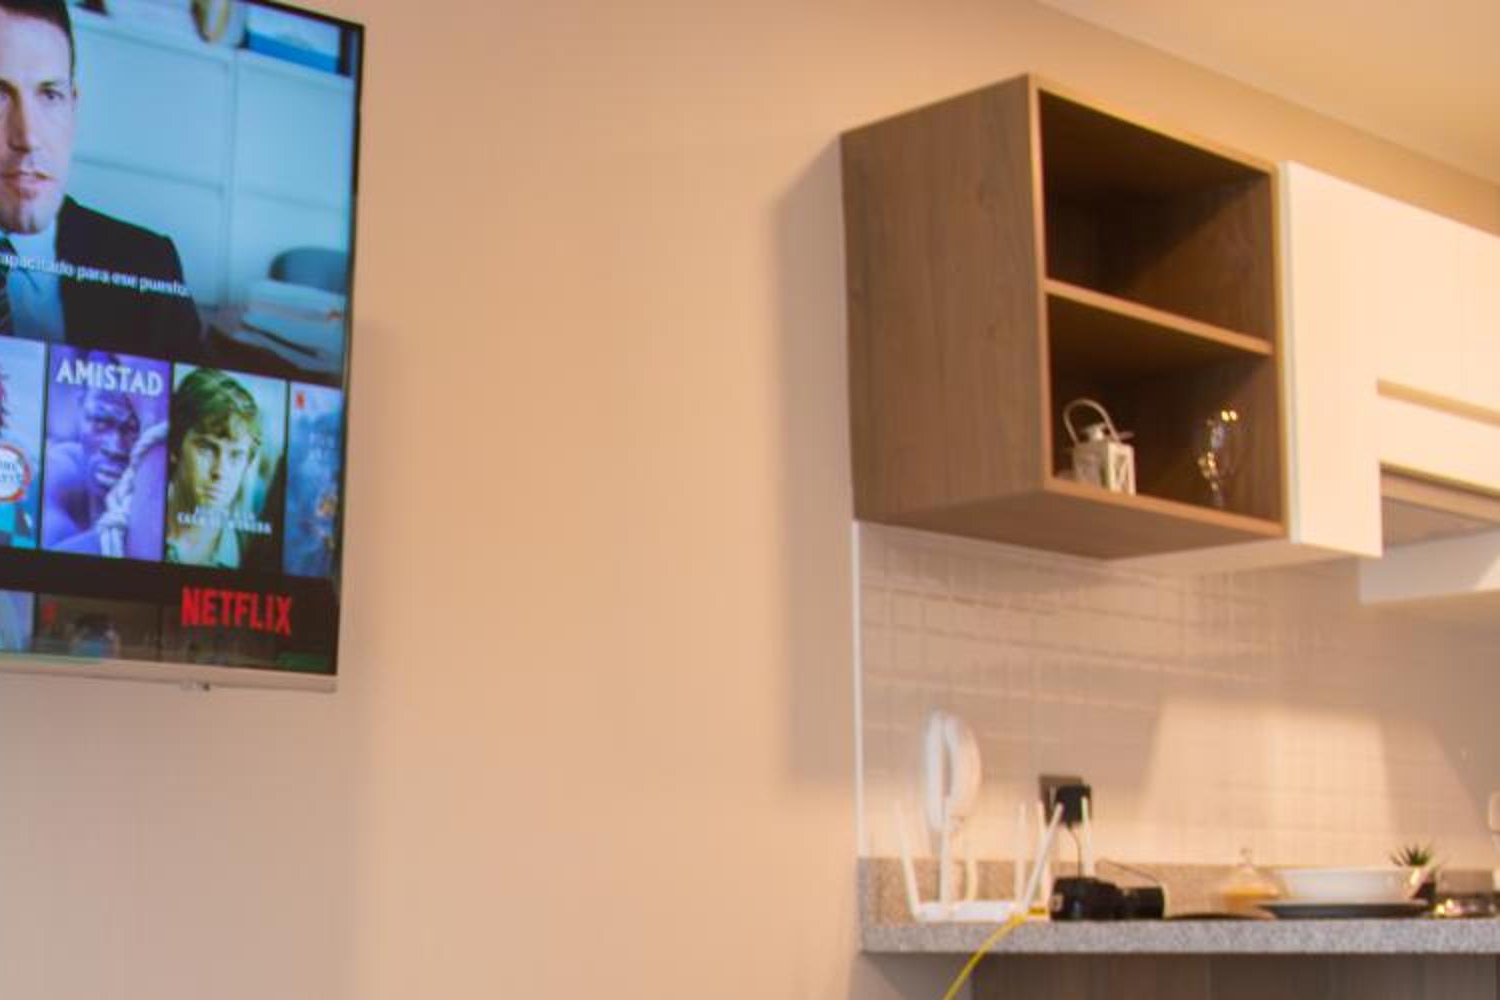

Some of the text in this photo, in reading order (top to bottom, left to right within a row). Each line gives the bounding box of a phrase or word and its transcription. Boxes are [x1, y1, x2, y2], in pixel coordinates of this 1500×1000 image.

[77, 266, 110, 285] para
[112, 272, 138, 287] ese
[56, 359, 163, 397] AMISTAD
[181, 586, 293, 637] NETFLIX
